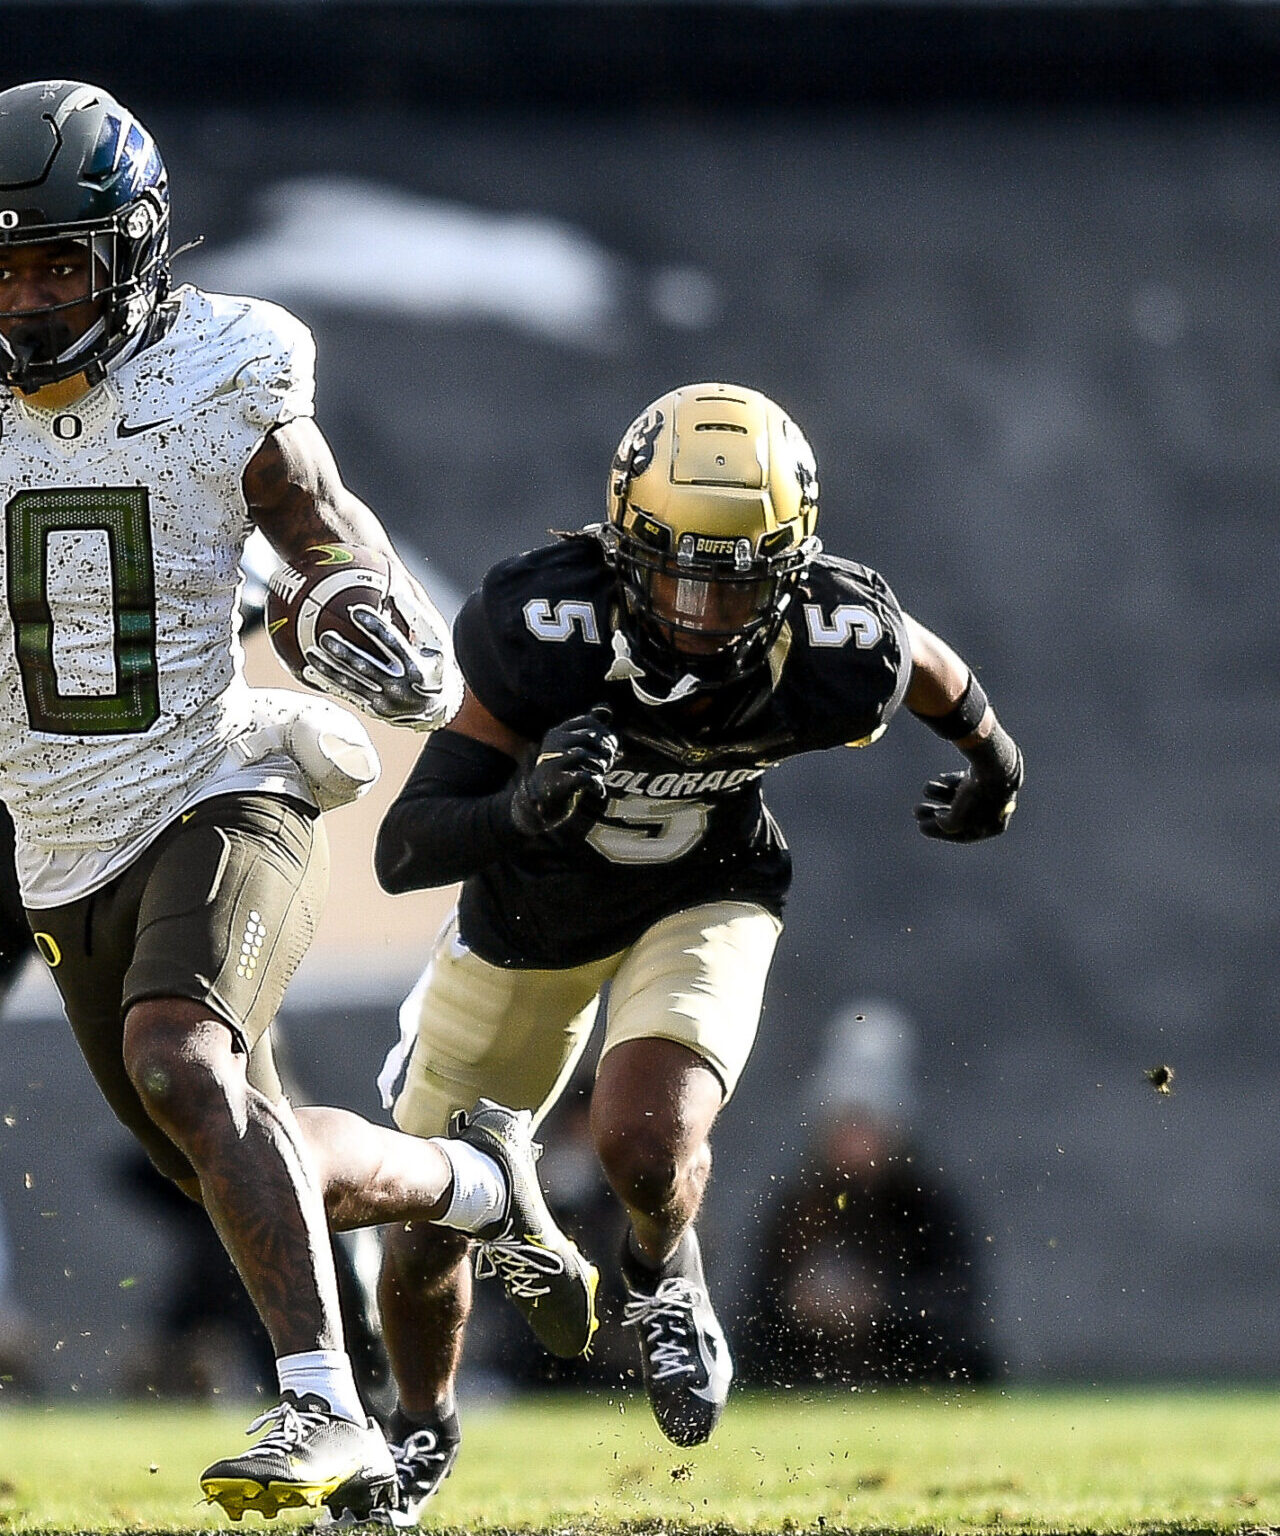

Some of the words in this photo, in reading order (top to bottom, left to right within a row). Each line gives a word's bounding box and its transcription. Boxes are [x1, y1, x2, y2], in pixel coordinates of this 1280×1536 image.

[696, 538, 735, 555] BUFFS
[5, 485, 161, 736] 0
[523, 599, 601, 644] 5
[802, 603, 883, 650] 5
[602, 769, 765, 798] OLORAD
[585, 794, 716, 865] 5
